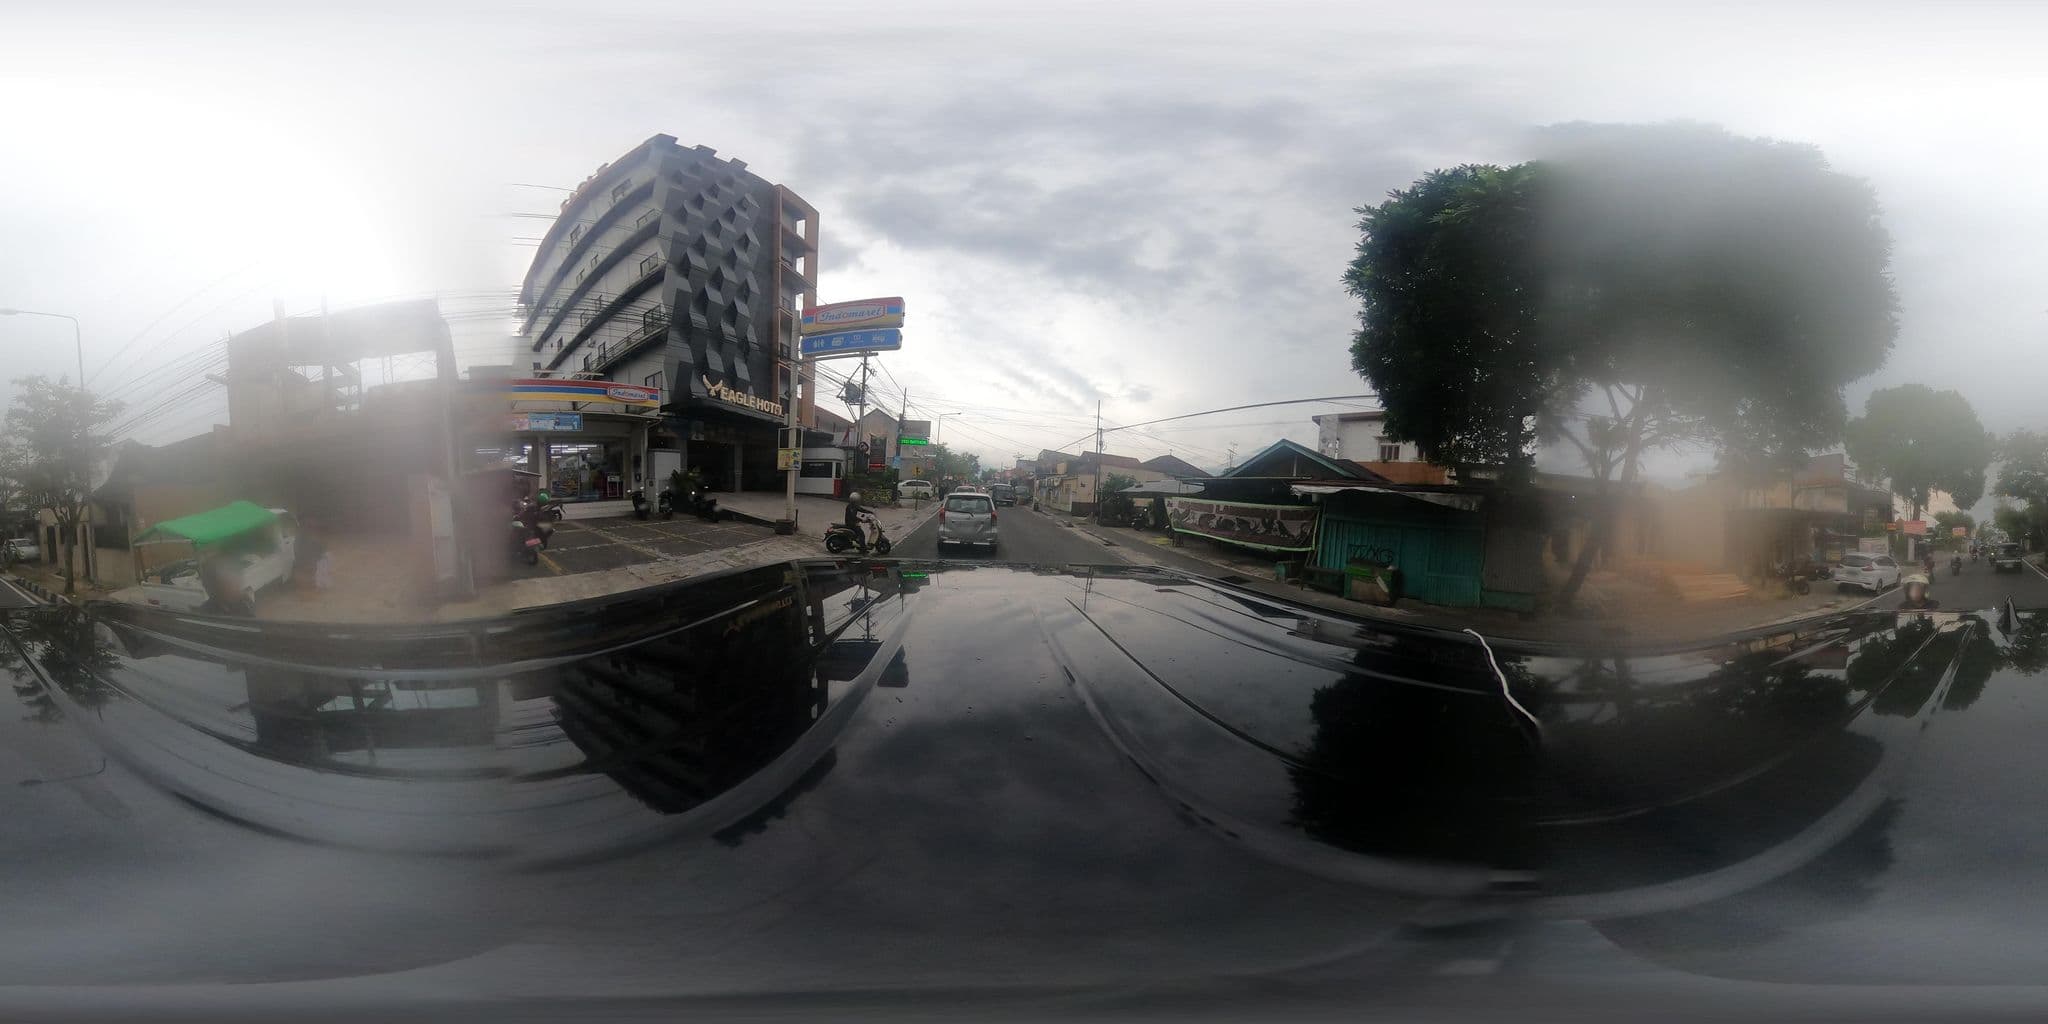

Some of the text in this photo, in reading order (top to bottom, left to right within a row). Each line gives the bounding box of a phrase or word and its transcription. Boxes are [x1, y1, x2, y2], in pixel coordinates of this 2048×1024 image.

[821, 308, 881, 321] Indomaret
[720, 386, 784, 416] EAGLE HOTEL
